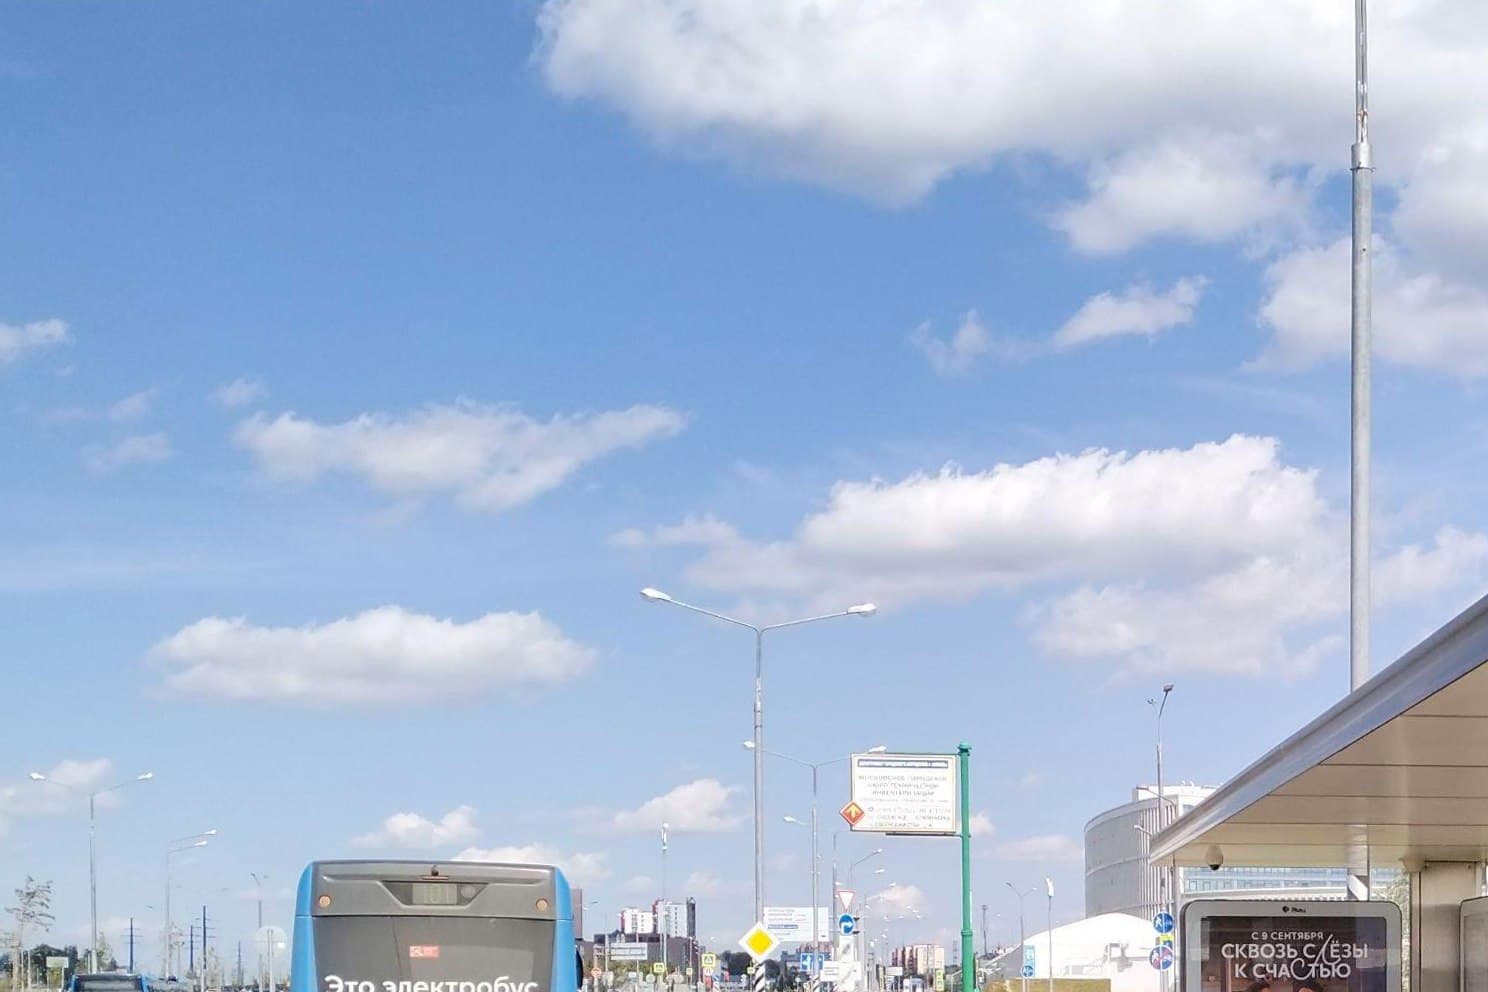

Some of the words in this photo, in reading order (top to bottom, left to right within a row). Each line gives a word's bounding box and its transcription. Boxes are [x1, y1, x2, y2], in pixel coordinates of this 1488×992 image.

[1251, 931, 1259, 940] С
[1261, 932, 1268, 940] 9
[1270, 931, 1324, 941] СЕНТЯБРЯ
[1221, 943, 1298, 959] СКВОЗЬ
[1303, 934, 1369, 965] СЛЁЗЫ
[1234, 963, 1248, 979] К
[1252, 957, 1352, 981] СЧАСТЬЮ
